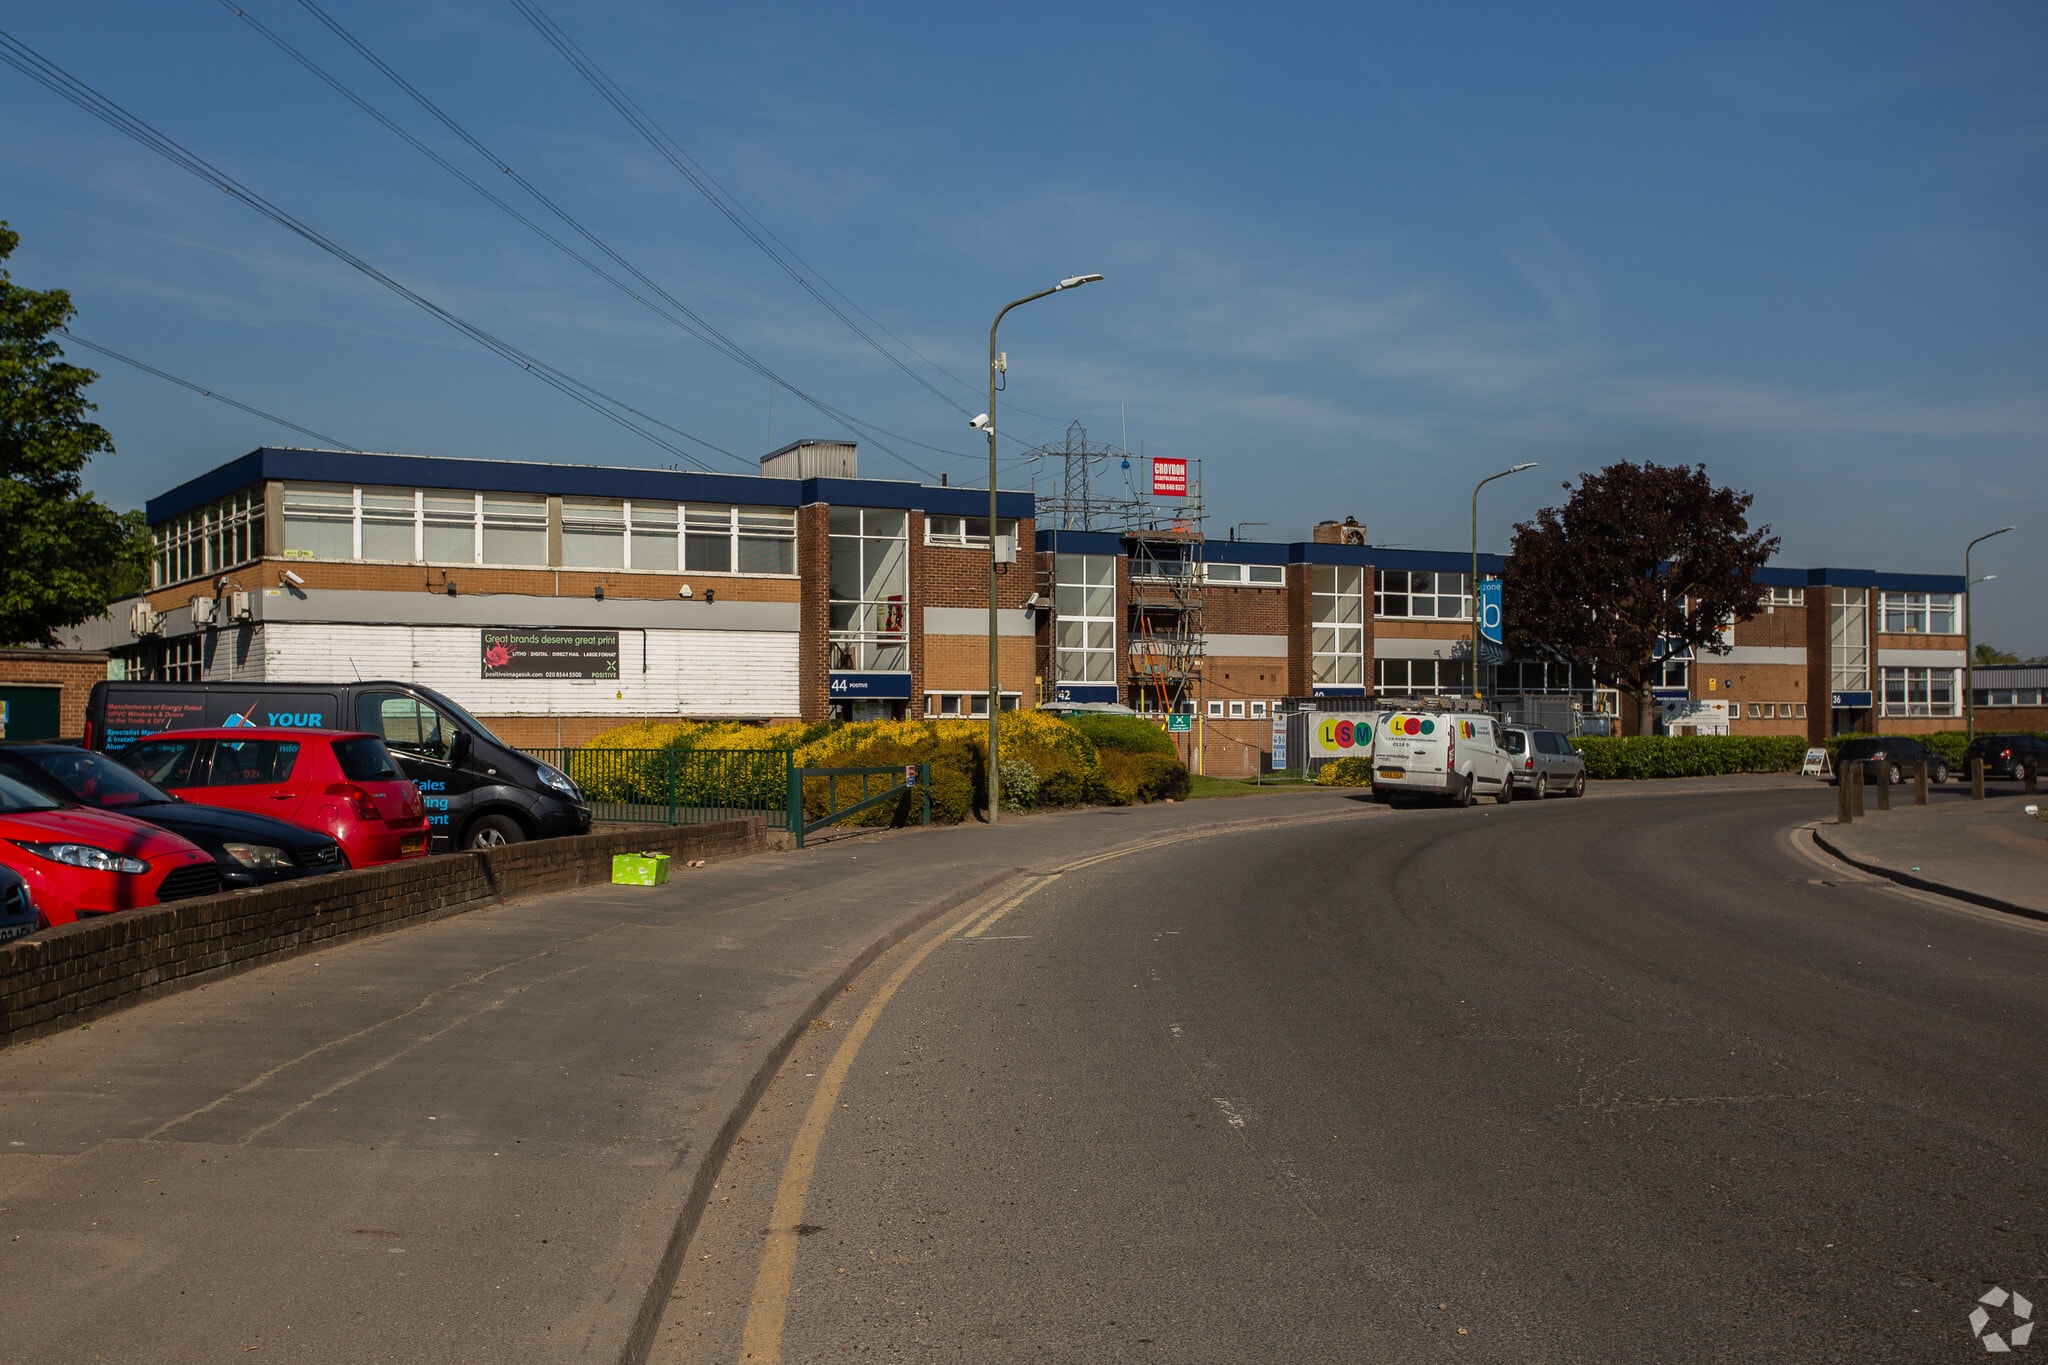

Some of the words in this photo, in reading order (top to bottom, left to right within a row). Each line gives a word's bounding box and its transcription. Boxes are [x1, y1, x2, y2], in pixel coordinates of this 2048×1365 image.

[1154, 463, 1185, 475] CROYDON
[1483, 594, 1500, 627] b
[485, 634, 508, 643] Great
[510, 635, 539, 644] brands
[541, 635, 573, 644] deserve
[575, 636, 596, 646] great
[597, 636, 616, 646] print
[831, 679, 847, 692] 44
[1058, 690, 1071, 700] 42
[1832, 695, 1841, 704] 36
[160, 704, 182, 712] Energy
[267, 713, 322, 727] YOUR
[1395, 720, 1433, 732] LSM
[1325, 726, 1369, 743] LSM
[411, 779, 446, 791] Sales
